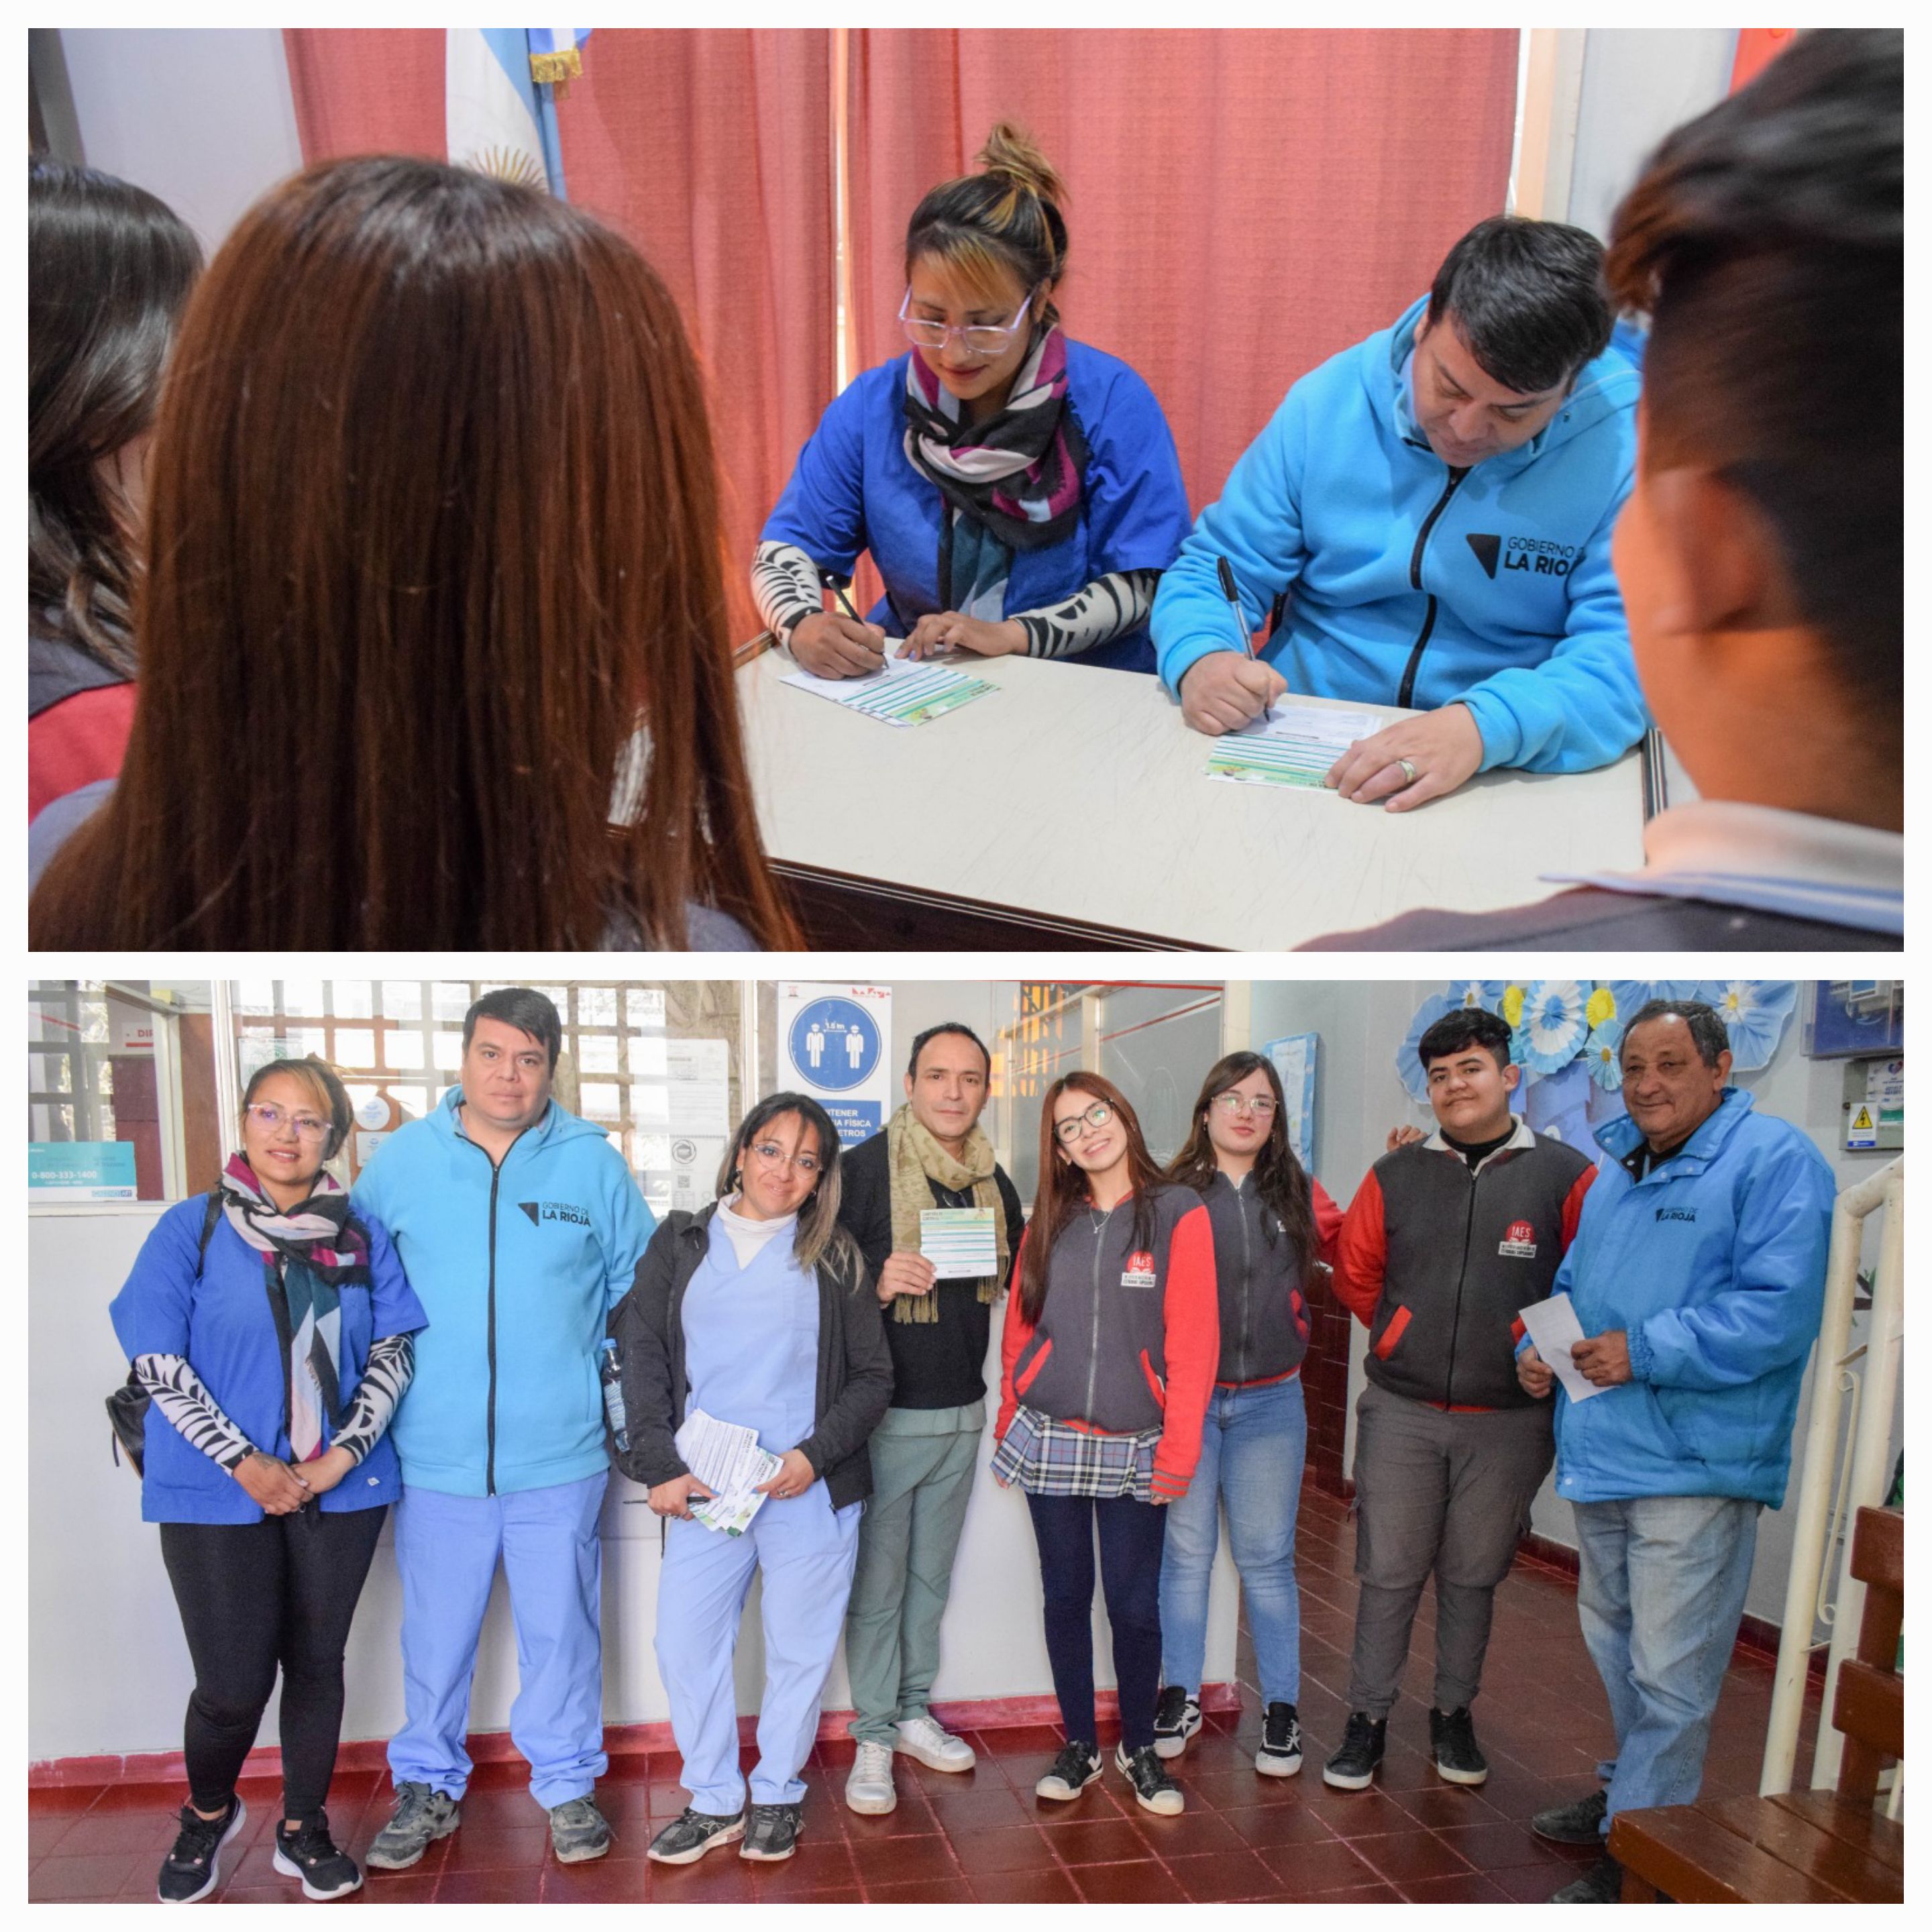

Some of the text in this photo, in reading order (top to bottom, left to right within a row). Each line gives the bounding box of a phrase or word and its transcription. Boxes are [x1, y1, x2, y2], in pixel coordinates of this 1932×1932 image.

[1507, 536, 1575, 558] GOBIERNO
[1504, 551, 1570, 576] LA RIO
[825, 1109, 859, 1117] NTENER
[844, 1118, 871, 1127] FÍSICA
[542, 1201, 580, 1213] GOBIERNO
[542, 1210, 591, 1228] LA RIOJA
[1511, 1226, 1531, 1238] IAES
[1133, 1256, 1151, 1267] IAES
